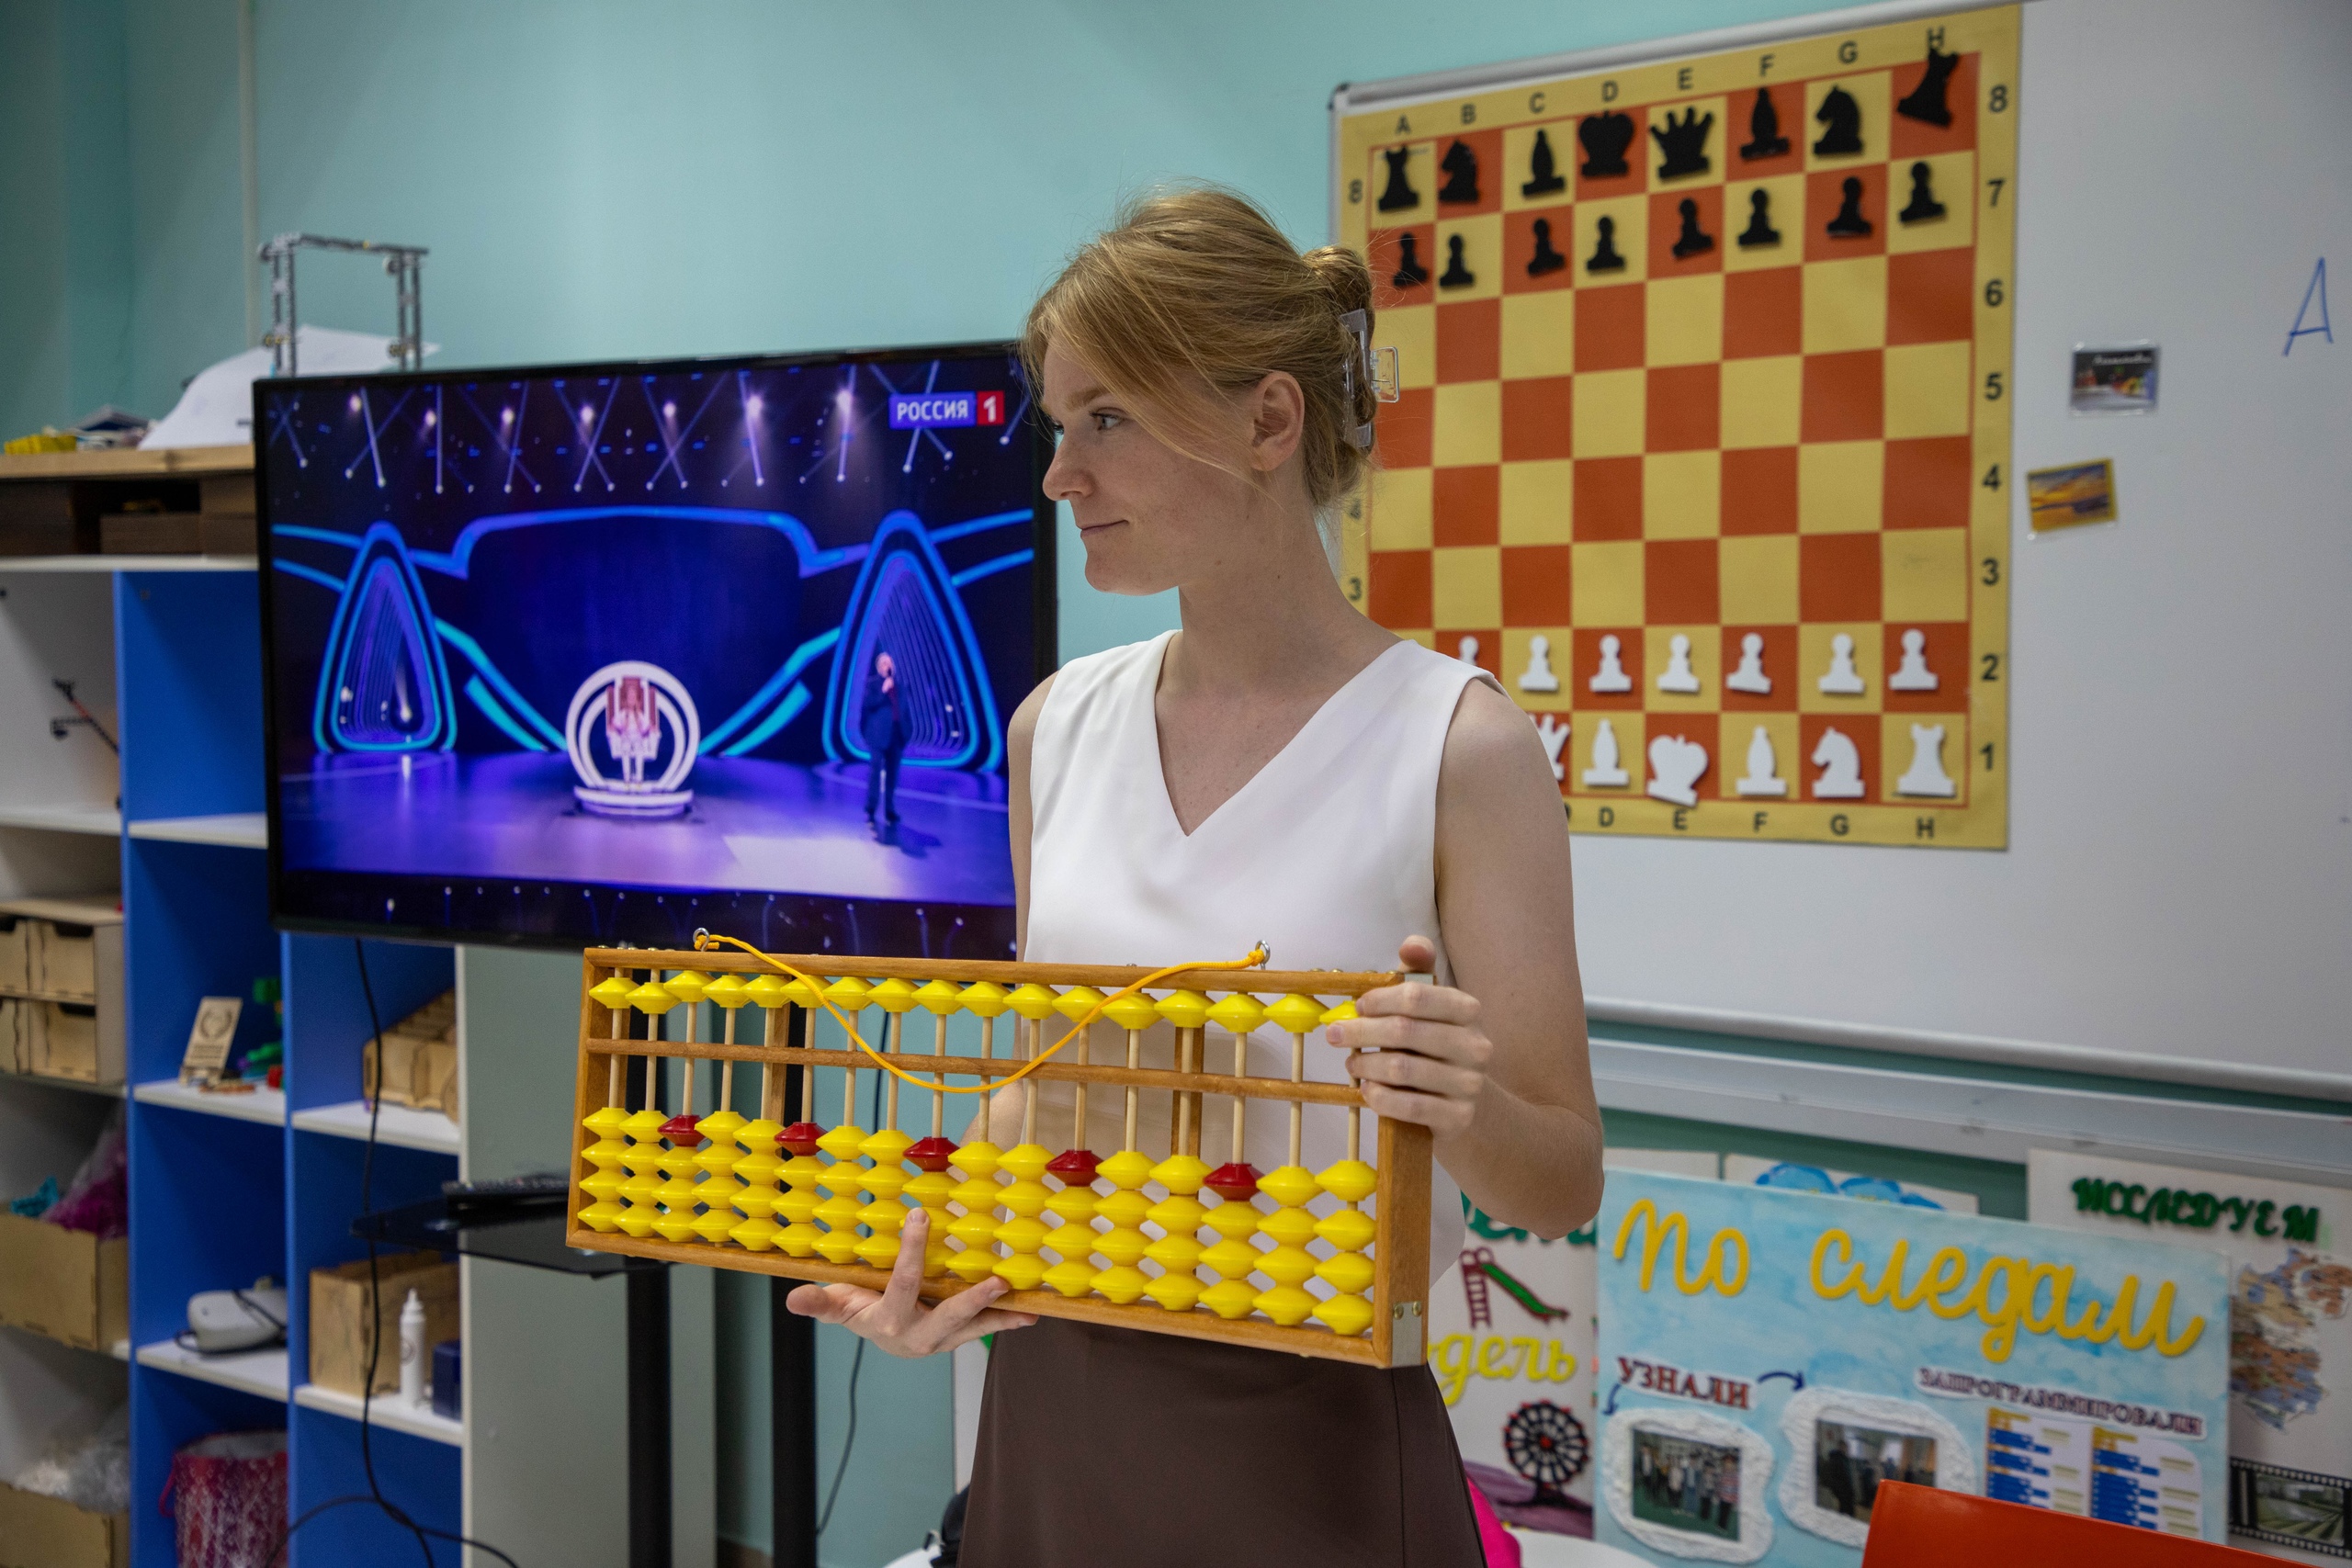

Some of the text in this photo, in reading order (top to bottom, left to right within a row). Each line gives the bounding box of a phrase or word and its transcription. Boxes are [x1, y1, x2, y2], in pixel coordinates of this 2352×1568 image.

[1396, 27, 1945, 136] A B C D E F G H
[1988, 85, 2007, 113] 8
[1988, 179, 2007, 208] 7
[1984, 278, 2004, 308] 6
[1984, 372, 2003, 400] 5
[897, 395, 997, 423] РОССИЯ 1
[1982, 464, 2001, 491] 4
[1982, 558, 2000, 586] 3
[1982, 653, 1999, 682] 2
[1980, 742, 1995, 772] 1
[1599, 807, 1935, 840] D E F G H
[1811, 1228, 2206, 1363] следам
[1617, 1357, 1751, 1409] УЗНАЛИ
